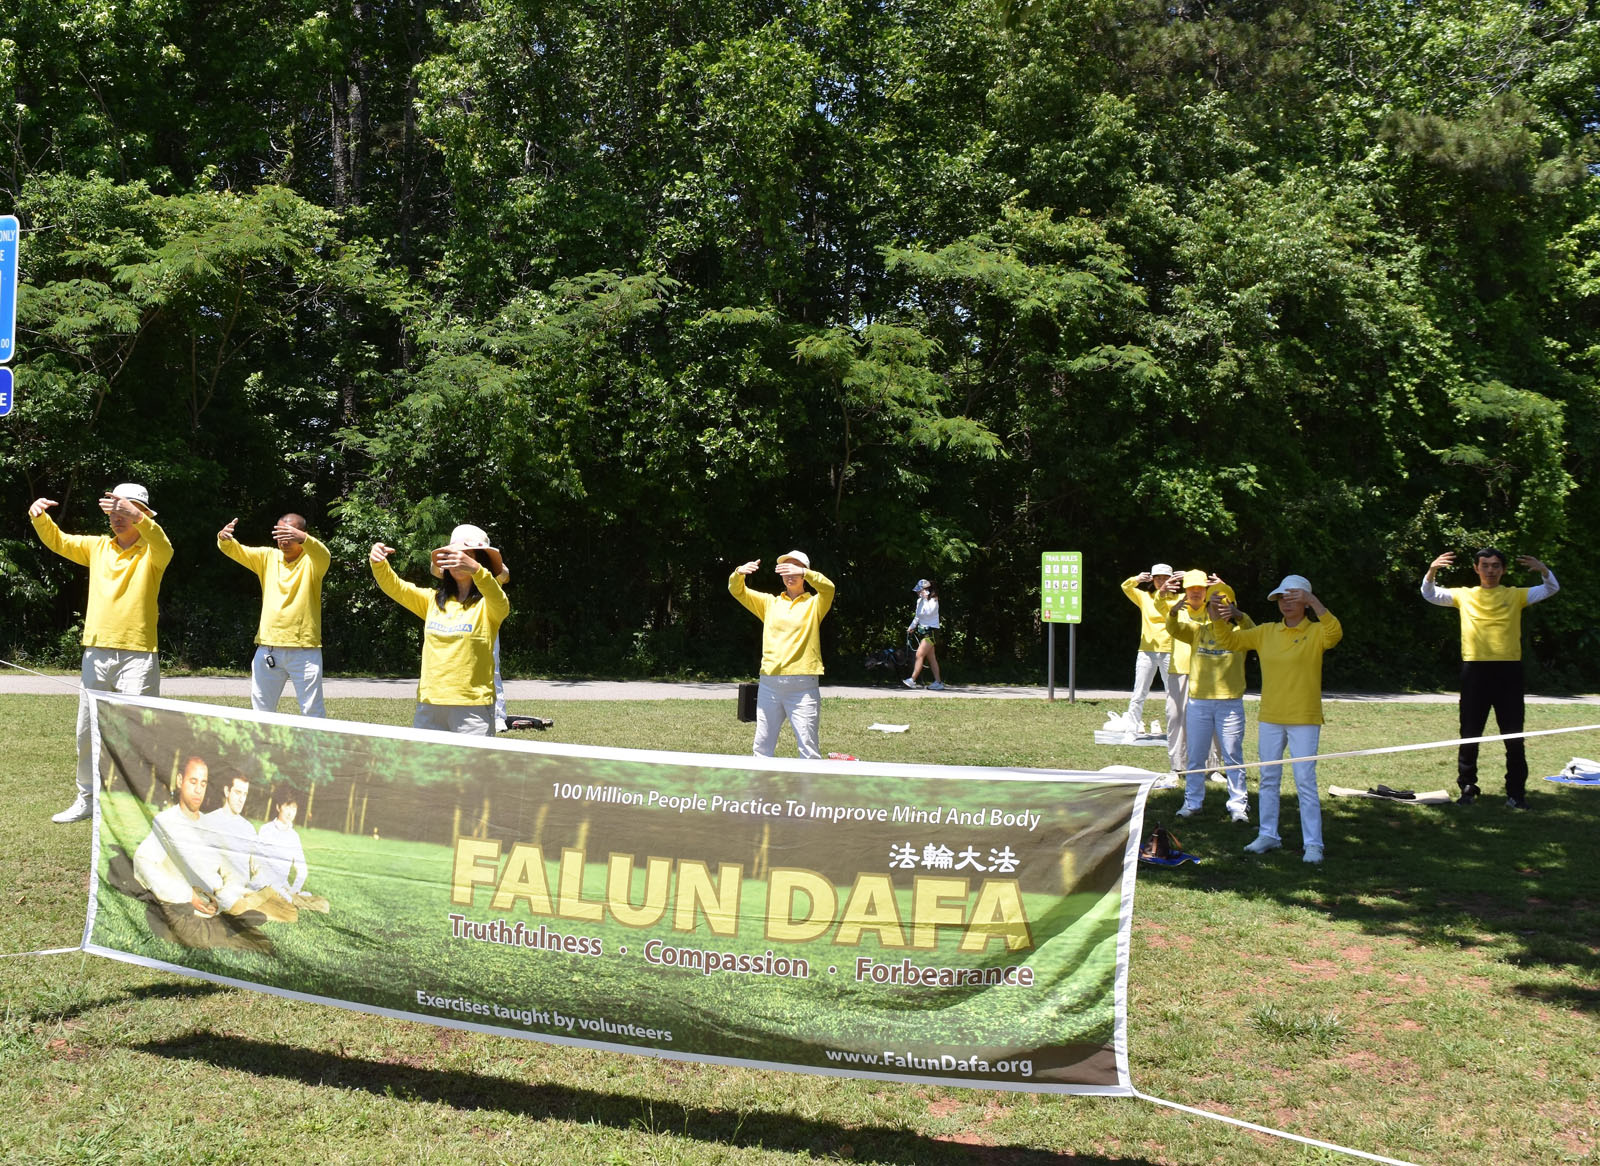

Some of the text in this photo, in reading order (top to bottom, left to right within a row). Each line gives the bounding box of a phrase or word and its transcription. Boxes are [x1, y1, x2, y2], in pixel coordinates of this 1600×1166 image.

[552, 783, 1041, 832] 100 Million People Practice To Improve Mind And Body
[889, 842, 1020, 873] 法輪大法
[450, 835, 1036, 954] FALUN DAFA
[449, 913, 1034, 986] Truthfulness Compassion Forbearance
[416, 990, 673, 1041] Exercises taught by volunteers
[826, 1050, 1033, 1077] www.FalunDafa.org
